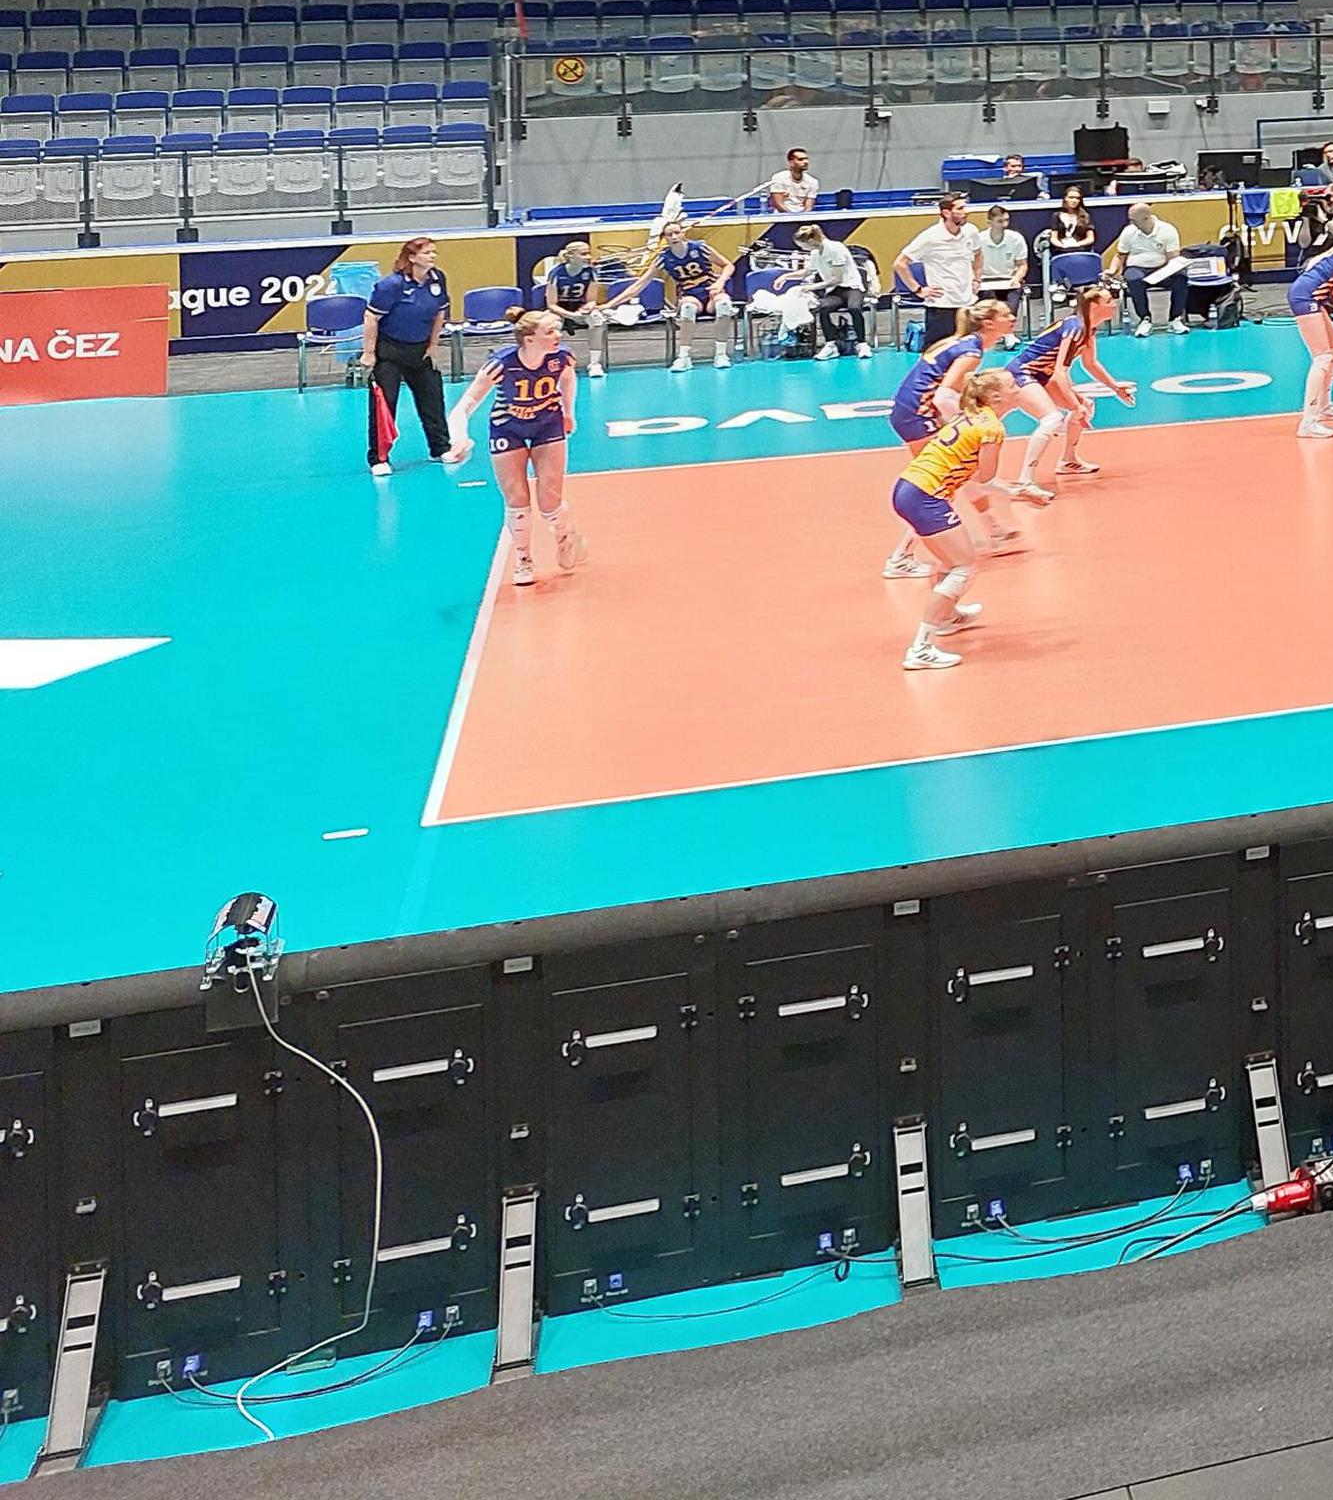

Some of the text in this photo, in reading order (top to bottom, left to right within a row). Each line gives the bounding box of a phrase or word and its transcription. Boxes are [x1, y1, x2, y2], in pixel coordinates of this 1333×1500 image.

[47, 329, 121, 360] ČEZ
[513, 376, 558, 401] 10
[489, 437, 509, 452] 10
